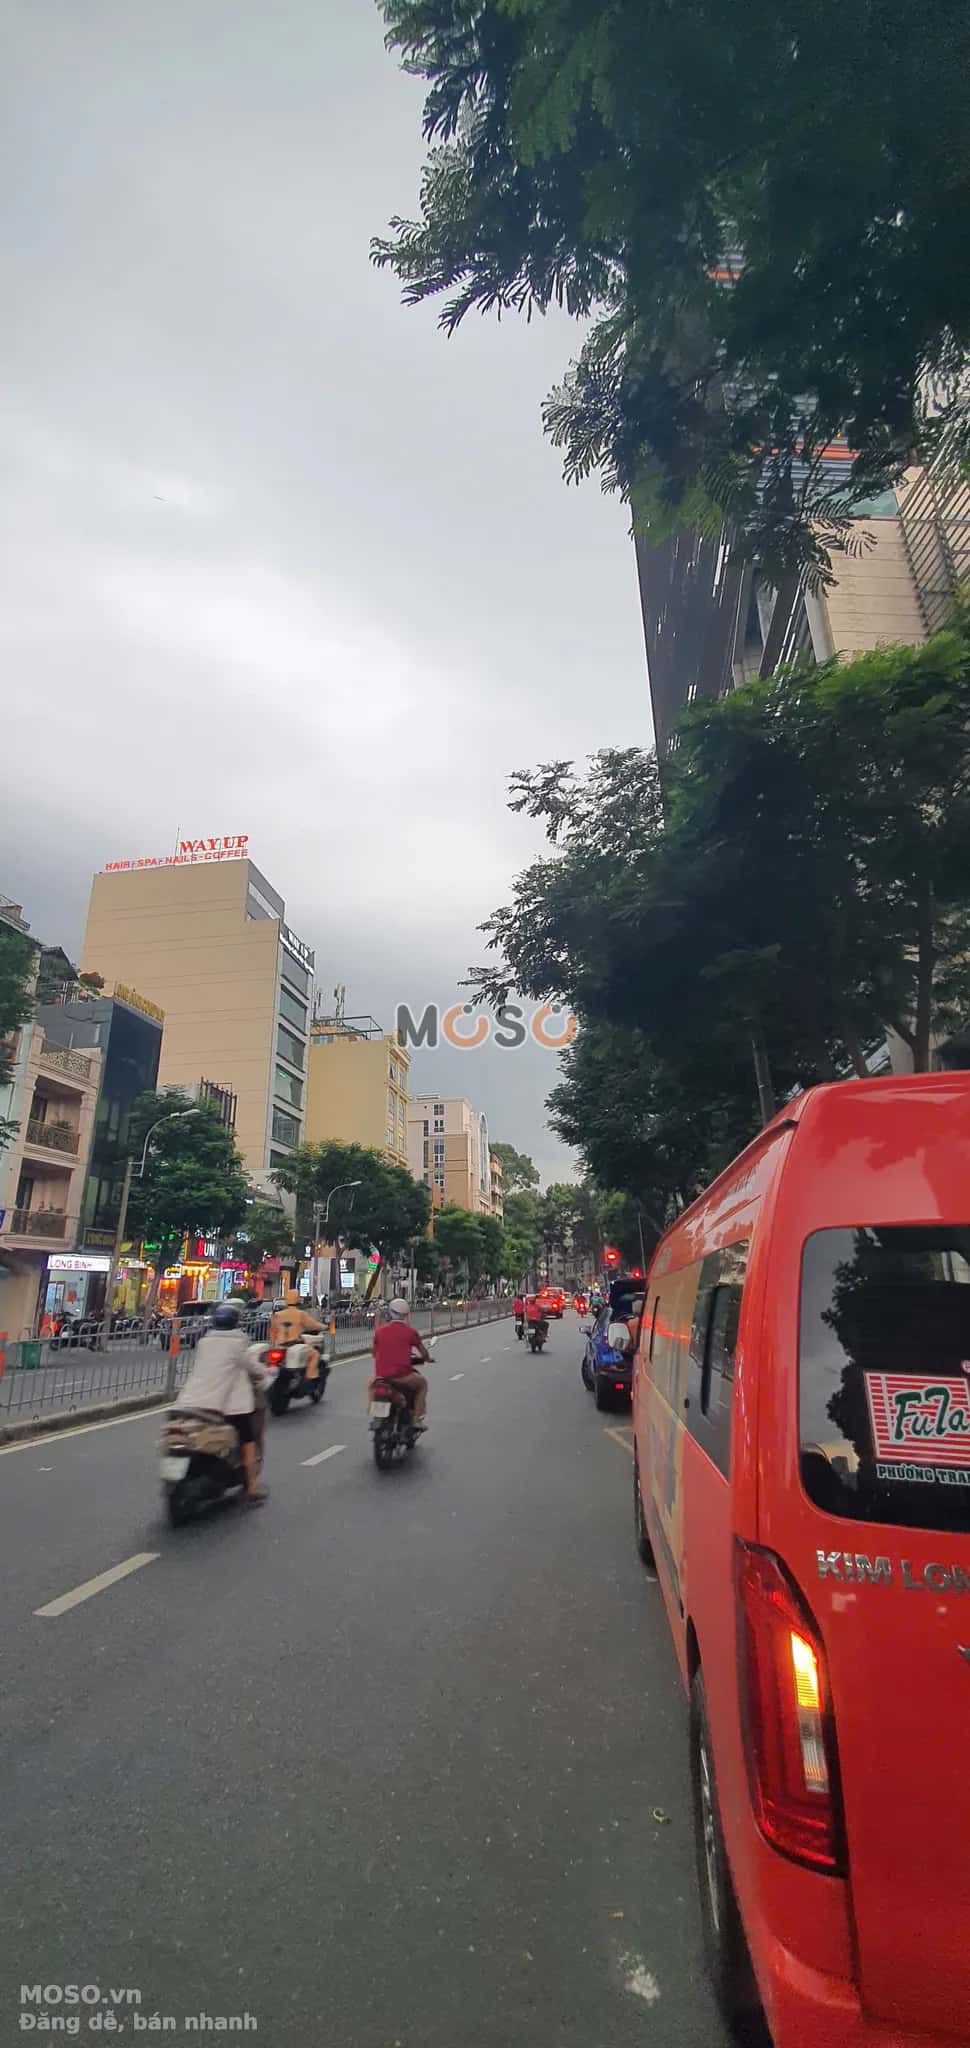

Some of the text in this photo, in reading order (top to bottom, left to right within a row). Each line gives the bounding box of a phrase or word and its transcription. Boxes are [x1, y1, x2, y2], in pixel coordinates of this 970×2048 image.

[179, 835, 249, 853] WAY UP
[105, 849, 249, 871] HAIR SPA NAILS COFFEE
[816, 1549, 893, 1586] KIM
